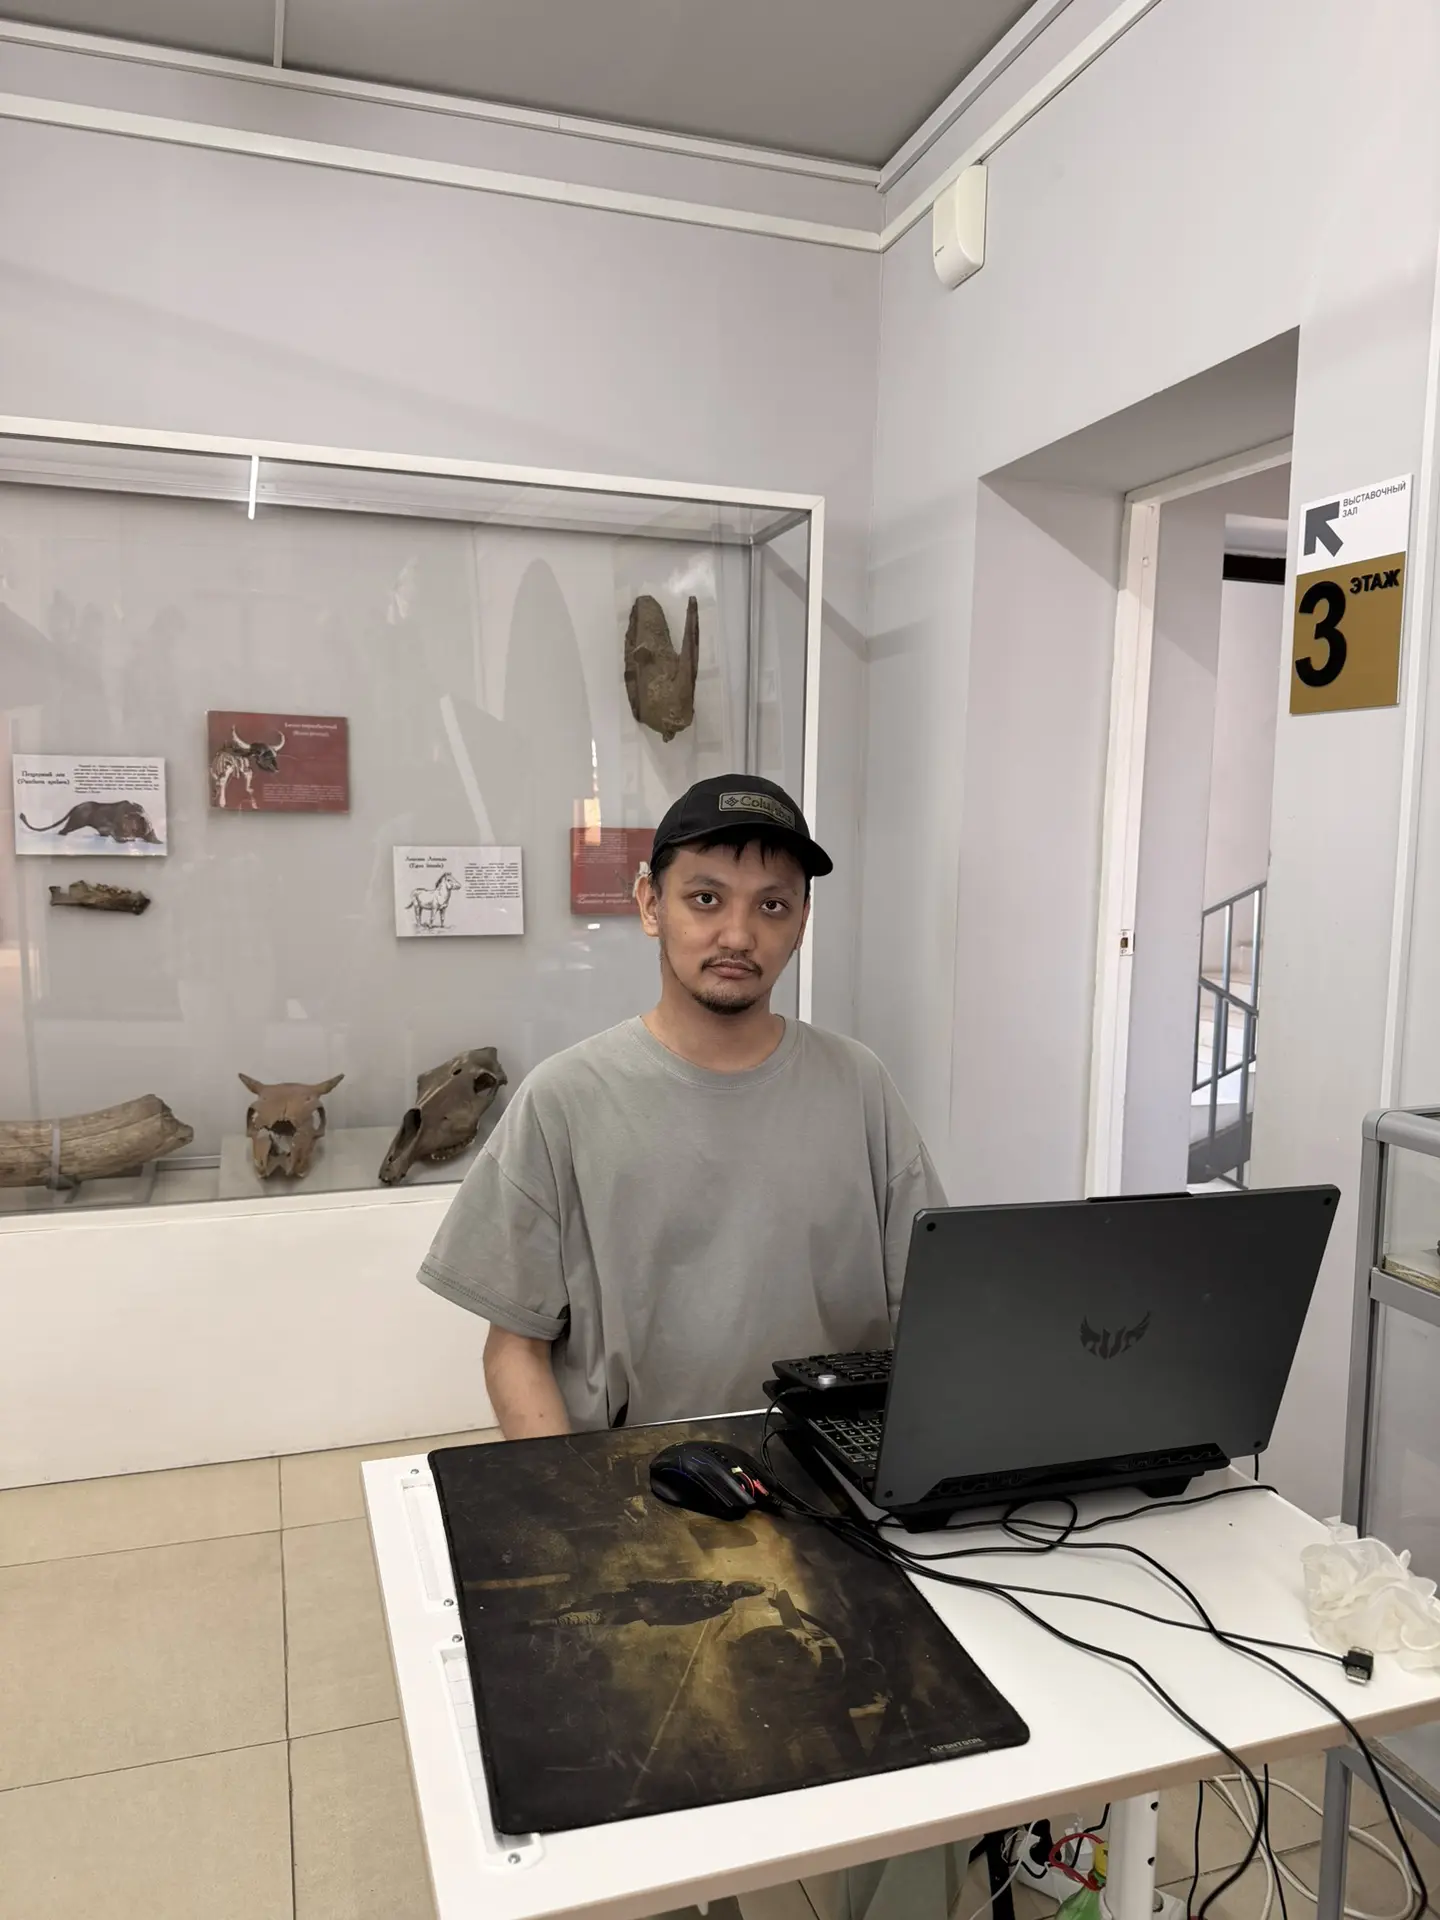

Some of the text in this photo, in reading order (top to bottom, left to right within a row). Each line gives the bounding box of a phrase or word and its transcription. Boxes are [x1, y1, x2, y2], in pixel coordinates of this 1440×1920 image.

[1342, 481, 1407, 507] ВЫСТАВОЧНЫЙ
[1342, 507, 1358, 518] ЗАЛ
[1350, 568, 1401, 595] ЭТАЖ
[1295, 580, 1348, 688] 3
[740, 795, 793, 824] Coluba
